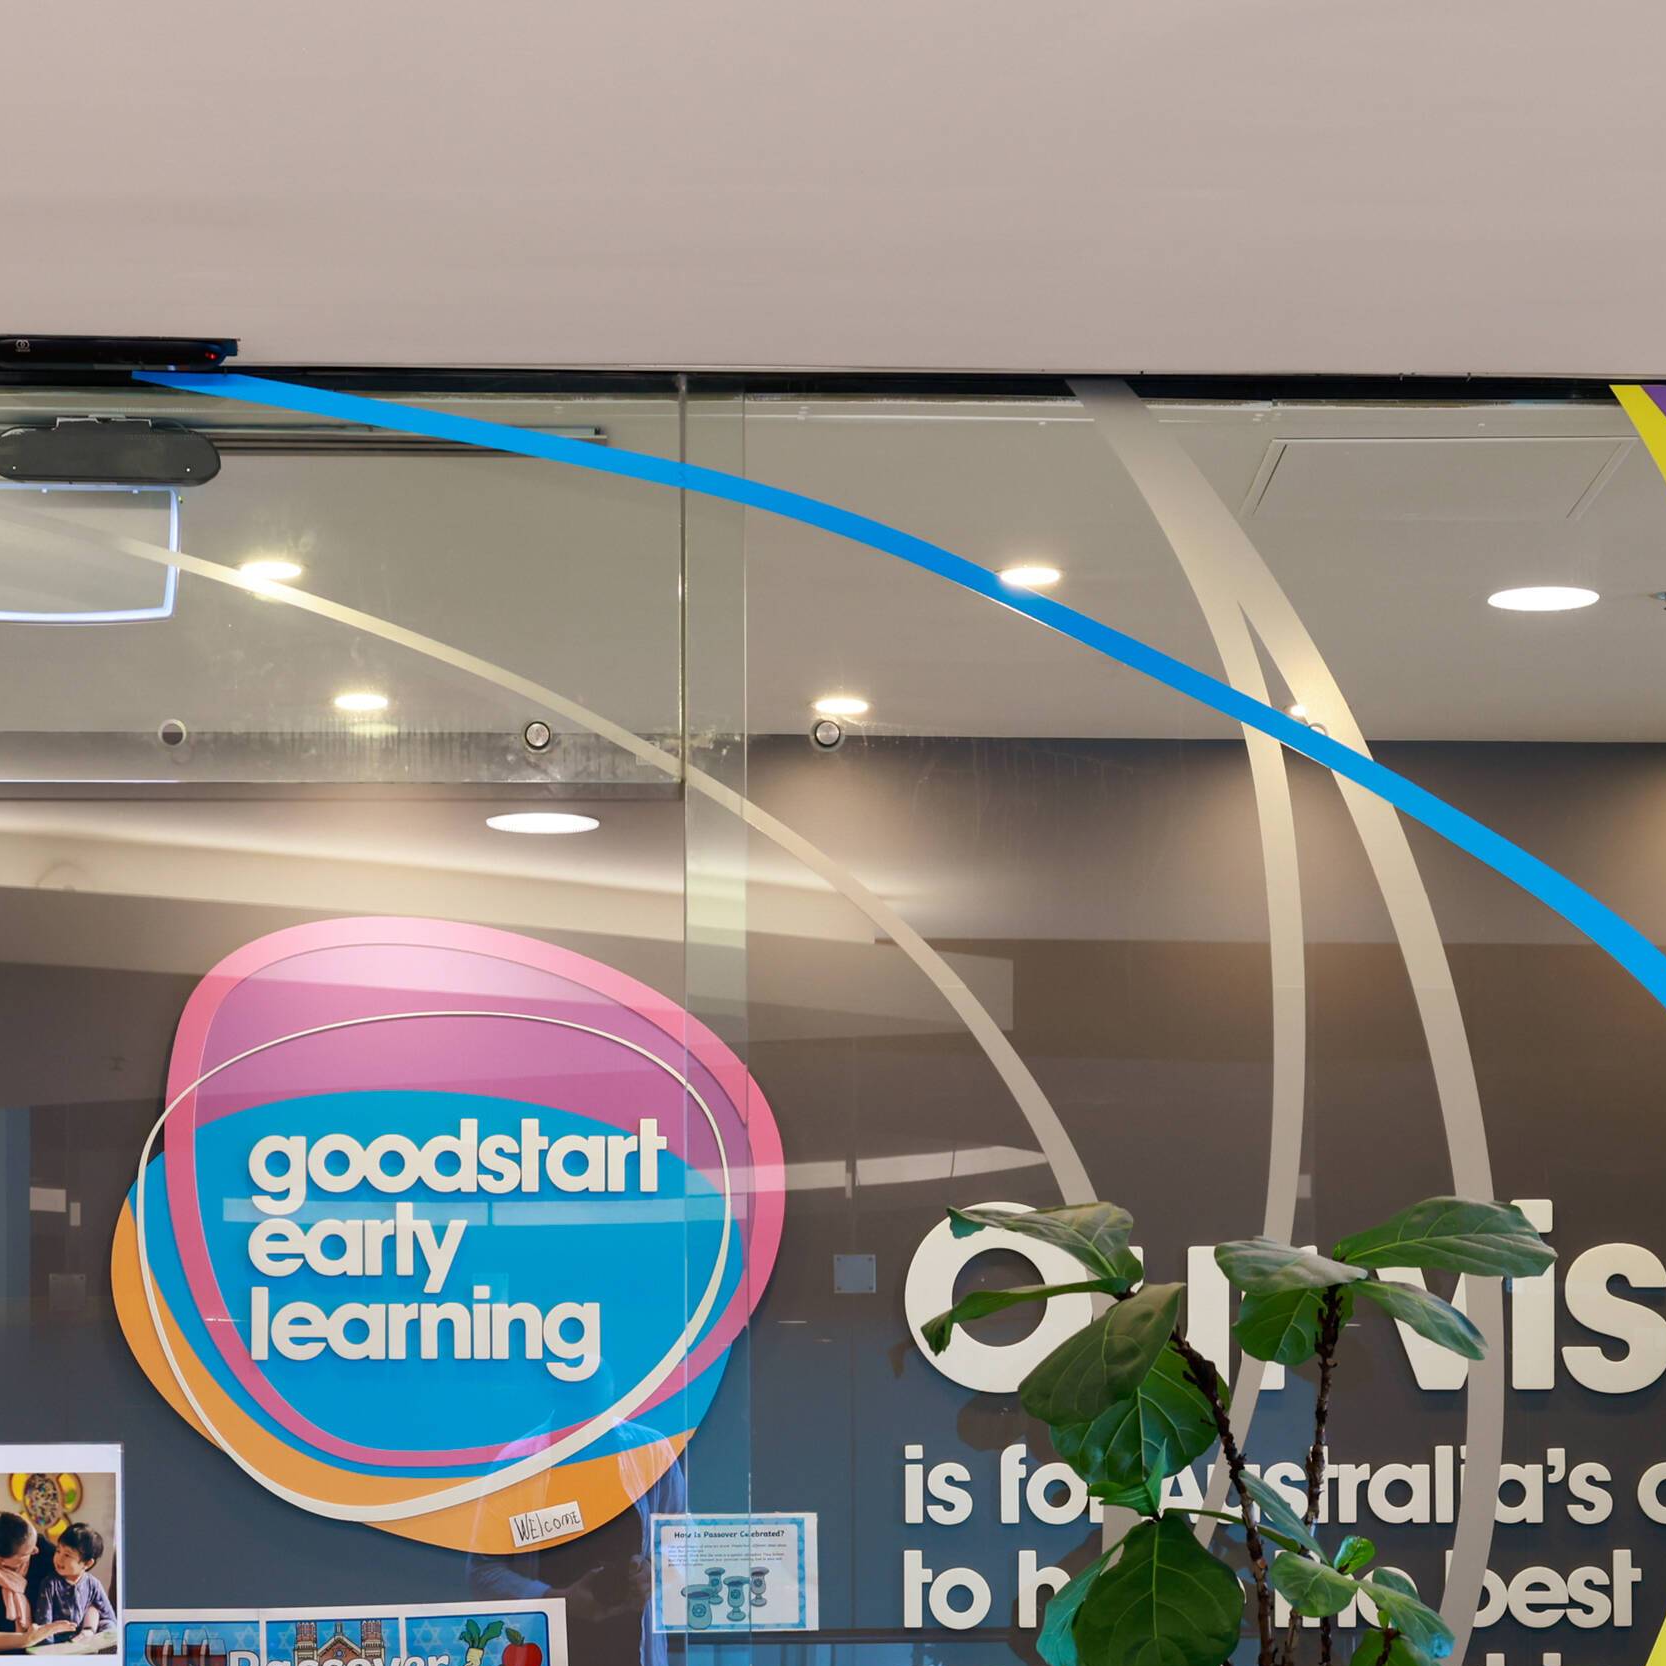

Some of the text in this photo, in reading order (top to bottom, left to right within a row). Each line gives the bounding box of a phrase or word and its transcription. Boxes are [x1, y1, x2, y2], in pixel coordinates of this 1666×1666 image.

[248, 1118, 667, 1215] goodstart
[248, 1202, 467, 1293] early
[251, 1285, 600, 1381] learning
[905, 1200, 1318, 1394] Ou
[904, 1444, 973, 1526] is
[704, 1531, 737, 1539] Passover
[904, 1550, 992, 1630] to
